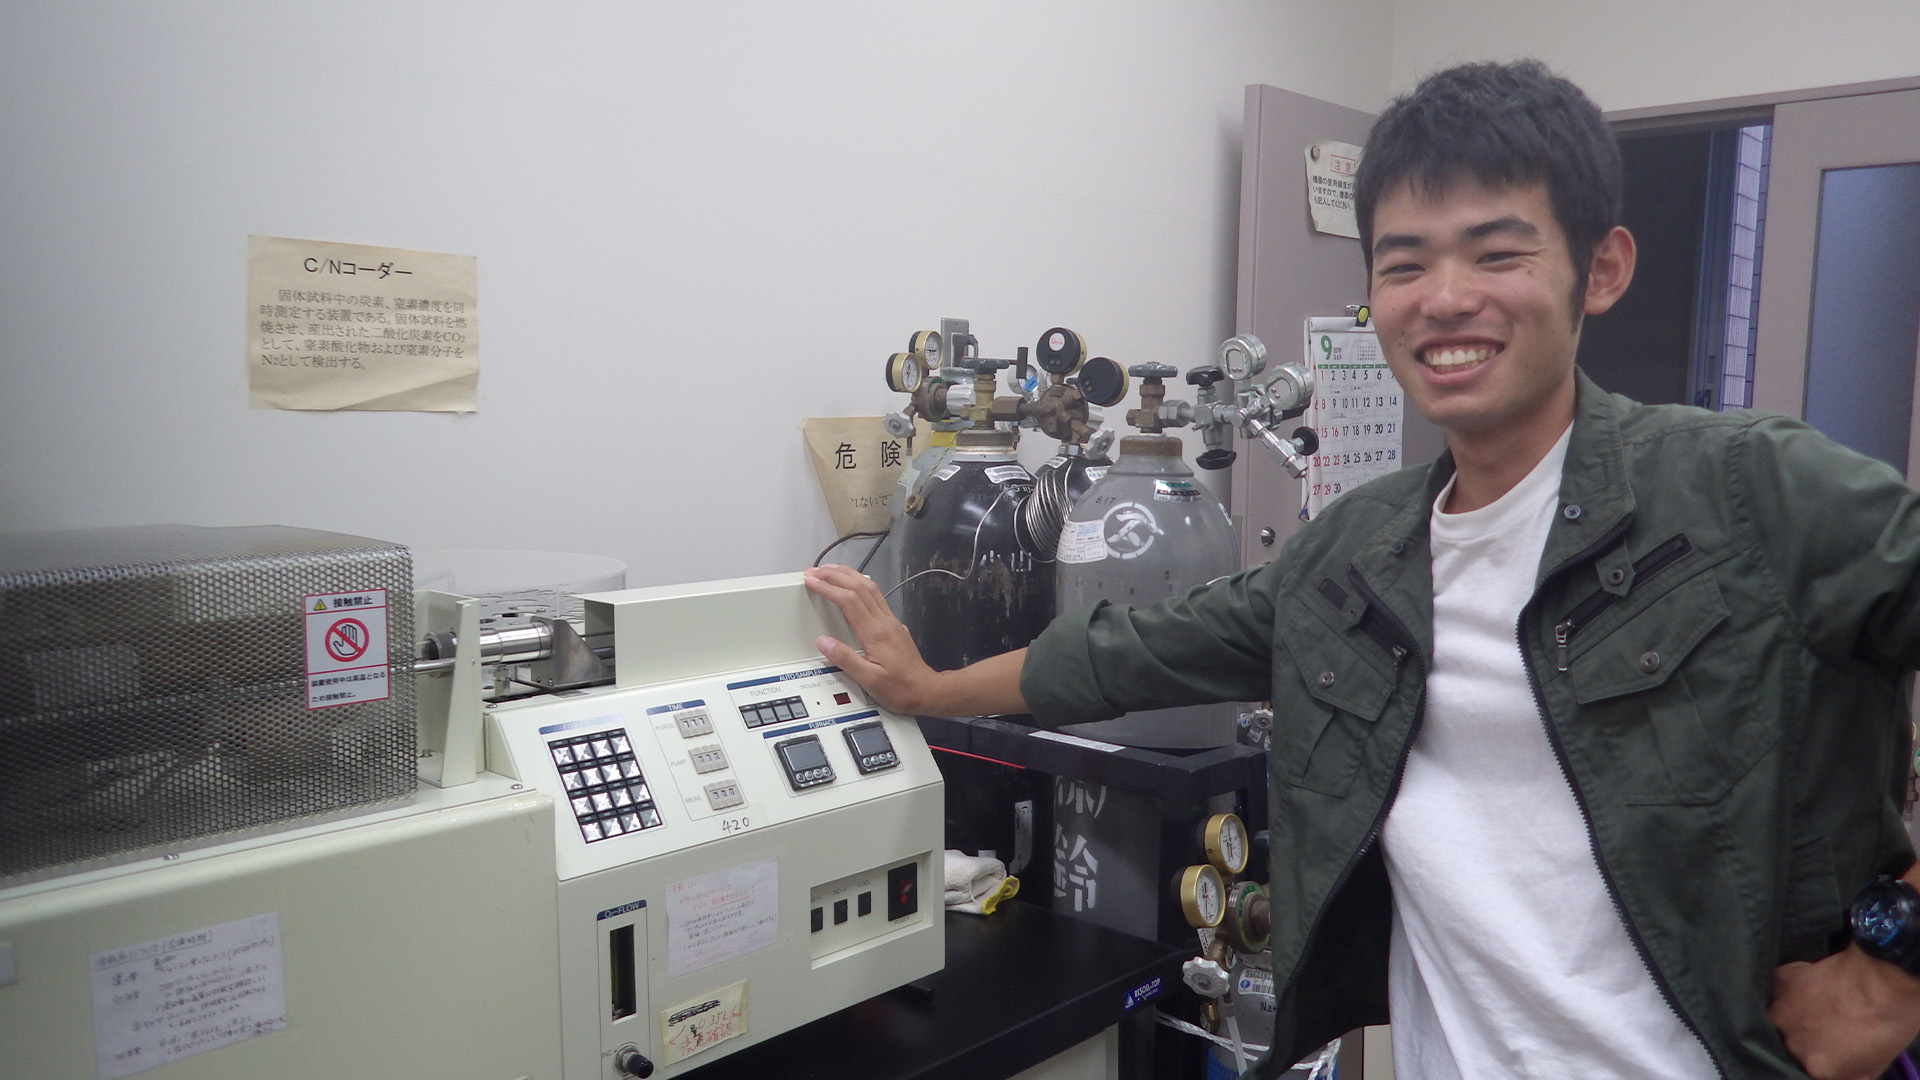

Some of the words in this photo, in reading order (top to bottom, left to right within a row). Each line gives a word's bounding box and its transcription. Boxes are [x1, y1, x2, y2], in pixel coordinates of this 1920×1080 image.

[303, 257, 413, 280] C/Nコーダー
[1320, 335, 1333, 360] 9
[1320, 370, 1324, 381] 1
[1331, 370, 1336, 381] 2
[1342, 370, 1347, 381] 3
[1352, 370, 1357, 380] 4
[1363, 370, 1369, 380] 5
[1376, 370, 1382, 380] 6
[1321, 398, 1326, 410] 8
[1332, 398, 1337, 409] 9
[1342, 398, 1348, 409] 10
[1352, 397, 1358, 408] 11
[1363, 397, 1371, 407] 12
[1375, 396, 1383, 407] 13
[1389, 396, 1397, 406] 14
[1321, 427, 1328, 438] 15
[1331, 426, 1339, 437] 16
[1342, 425, 1349, 436] 17
[1352, 425, 1360, 436] 18
[1363, 424, 1371, 435] 19
[1375, 423, 1383, 434] 20
[1387, 423, 1396, 434] 21
[835, 439, 902, 470] 危険
[1322, 455, 1330, 467] 22
[1333, 454, 1340, 466] 23
[1342, 453, 1350, 465] 24
[1353, 453, 1360, 463] 25
[1363, 452, 1372, 462] 26
[1375, 450, 1383, 461] 27
[1387, 449, 1396, 460] 28
[1313, 456, 1321, 467] 20
[1312, 484, 1321, 495] 27
[1324, 484, 1331, 495] 29
[1333, 483, 1341, 494] 30
[333, 595, 373, 608] 接触禁止
[311, 671, 386, 688] 装置使用中は高温となる
[779, 673, 796, 682] AUTO
[796, 669, 823, 679] SAMPLER
[749, 685, 782, 697] FUNCTION
[668, 702, 684, 711] TIME
[808, 718, 837, 729] FURNACE
[670, 758, 687, 767] PUMP
[722, 816, 750, 834] 420
[857, 879, 871, 888] COOL
